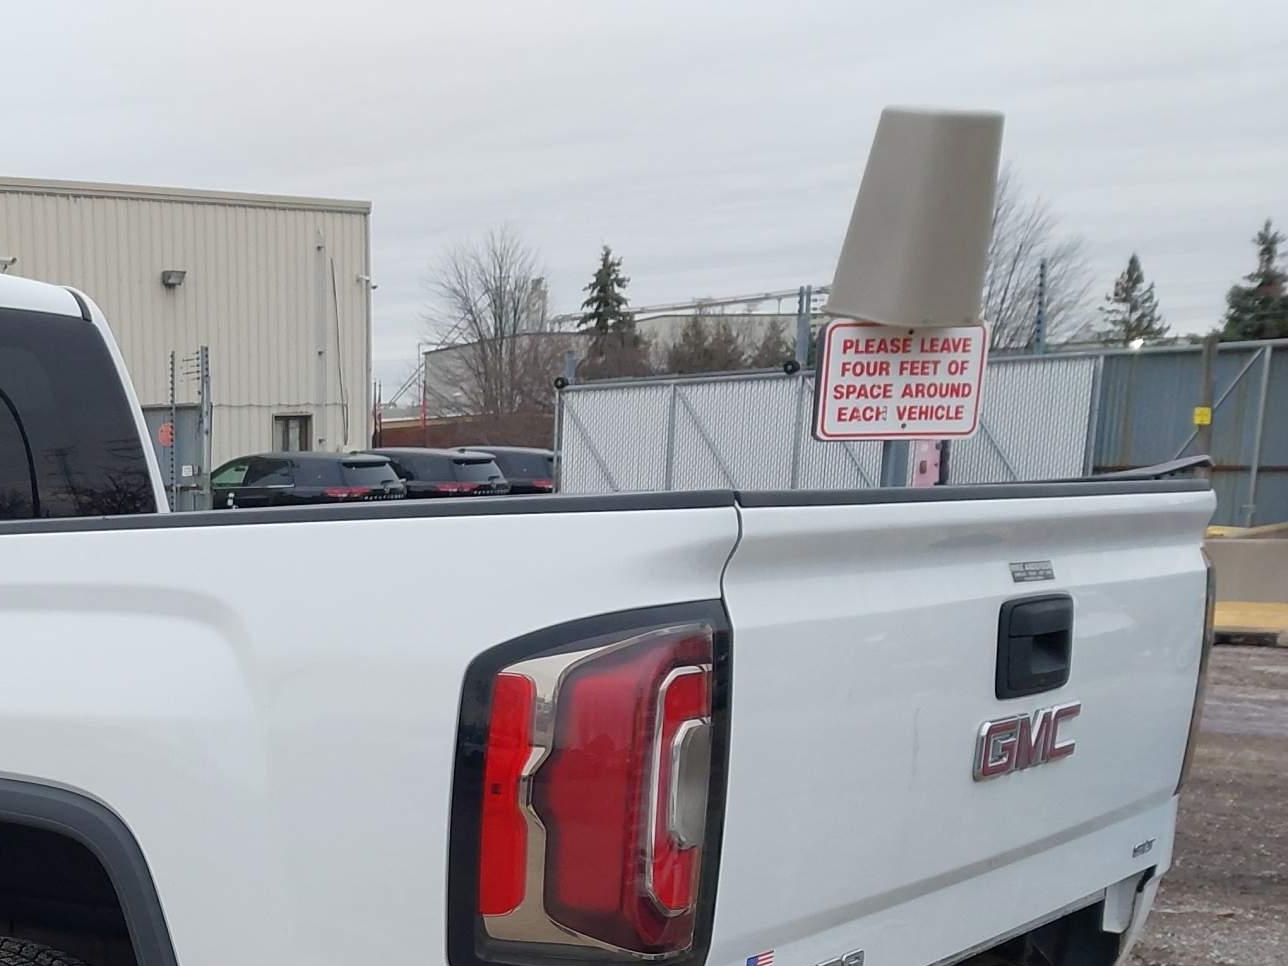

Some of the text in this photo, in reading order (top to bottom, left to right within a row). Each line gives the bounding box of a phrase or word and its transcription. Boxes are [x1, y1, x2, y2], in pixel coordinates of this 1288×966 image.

[842, 337, 972, 355] PLEASE LEAVE
[840, 360, 969, 377] FOUR FEET OF
[833, 383, 972, 400] SPACE AROUND
[837, 405, 964, 422] EACH VEHICLE
[972, 701, 1081, 783] GMC
